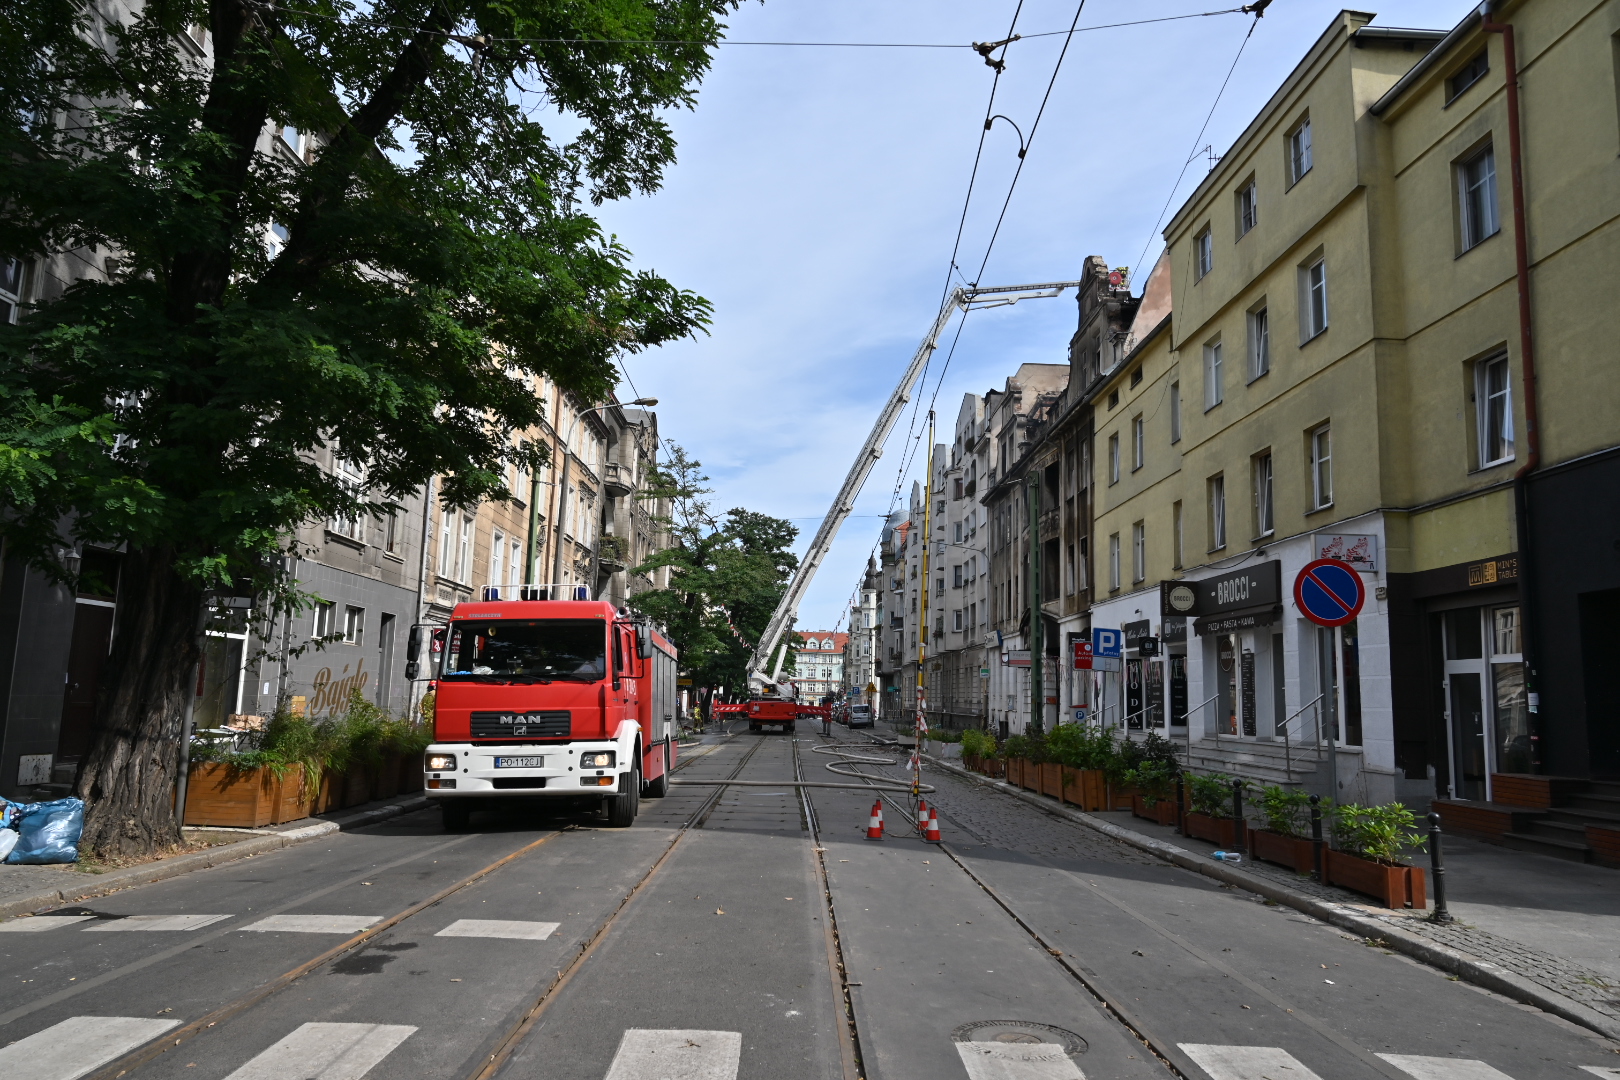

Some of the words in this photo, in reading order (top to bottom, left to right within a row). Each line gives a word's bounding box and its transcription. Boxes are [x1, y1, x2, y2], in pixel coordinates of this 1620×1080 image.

[1498, 569, 1517, 579] TABLE
[1217, 575, 1249, 605] BROCCI
[1207, 623, 1220, 631] PIZZA
[1223, 620, 1237, 629] PASTA
[1240, 617, 1255, 626] KAWA
[1098, 631, 1115, 654] P
[310, 657, 368, 717] Bajgle
[499, 715, 541, 724] MAN
